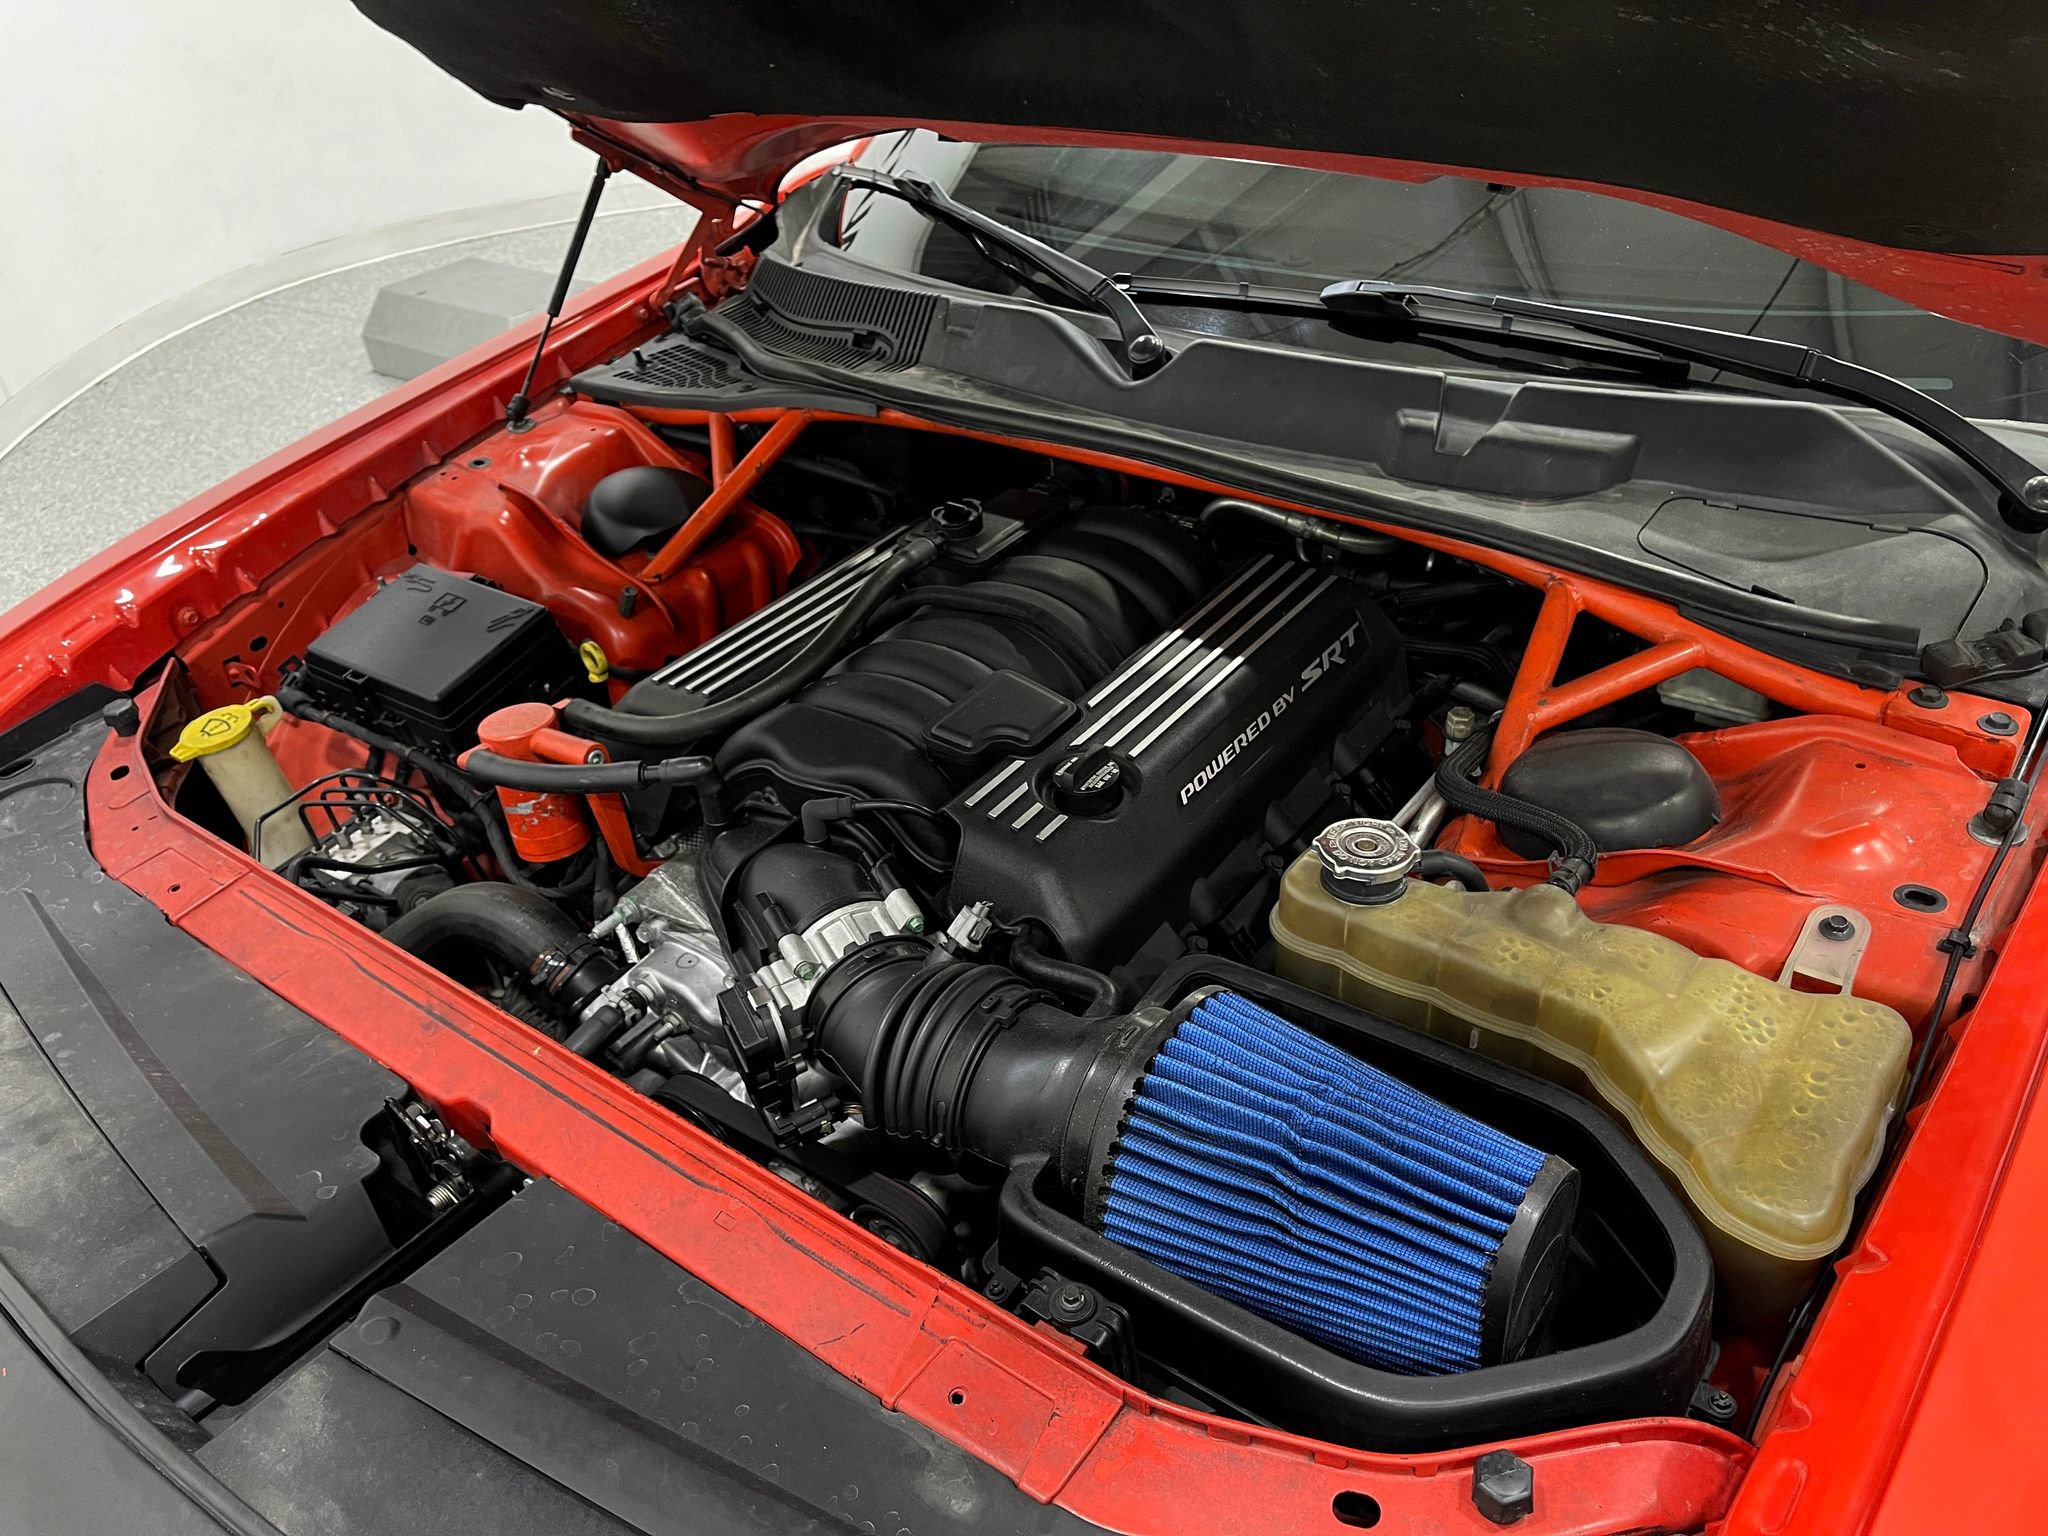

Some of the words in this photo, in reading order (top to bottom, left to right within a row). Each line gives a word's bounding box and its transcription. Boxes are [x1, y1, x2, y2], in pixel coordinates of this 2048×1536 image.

[1179, 711, 1272, 806] POWERED
[1272, 685, 1296, 718] BY
[1301, 621, 1360, 692] SRT
